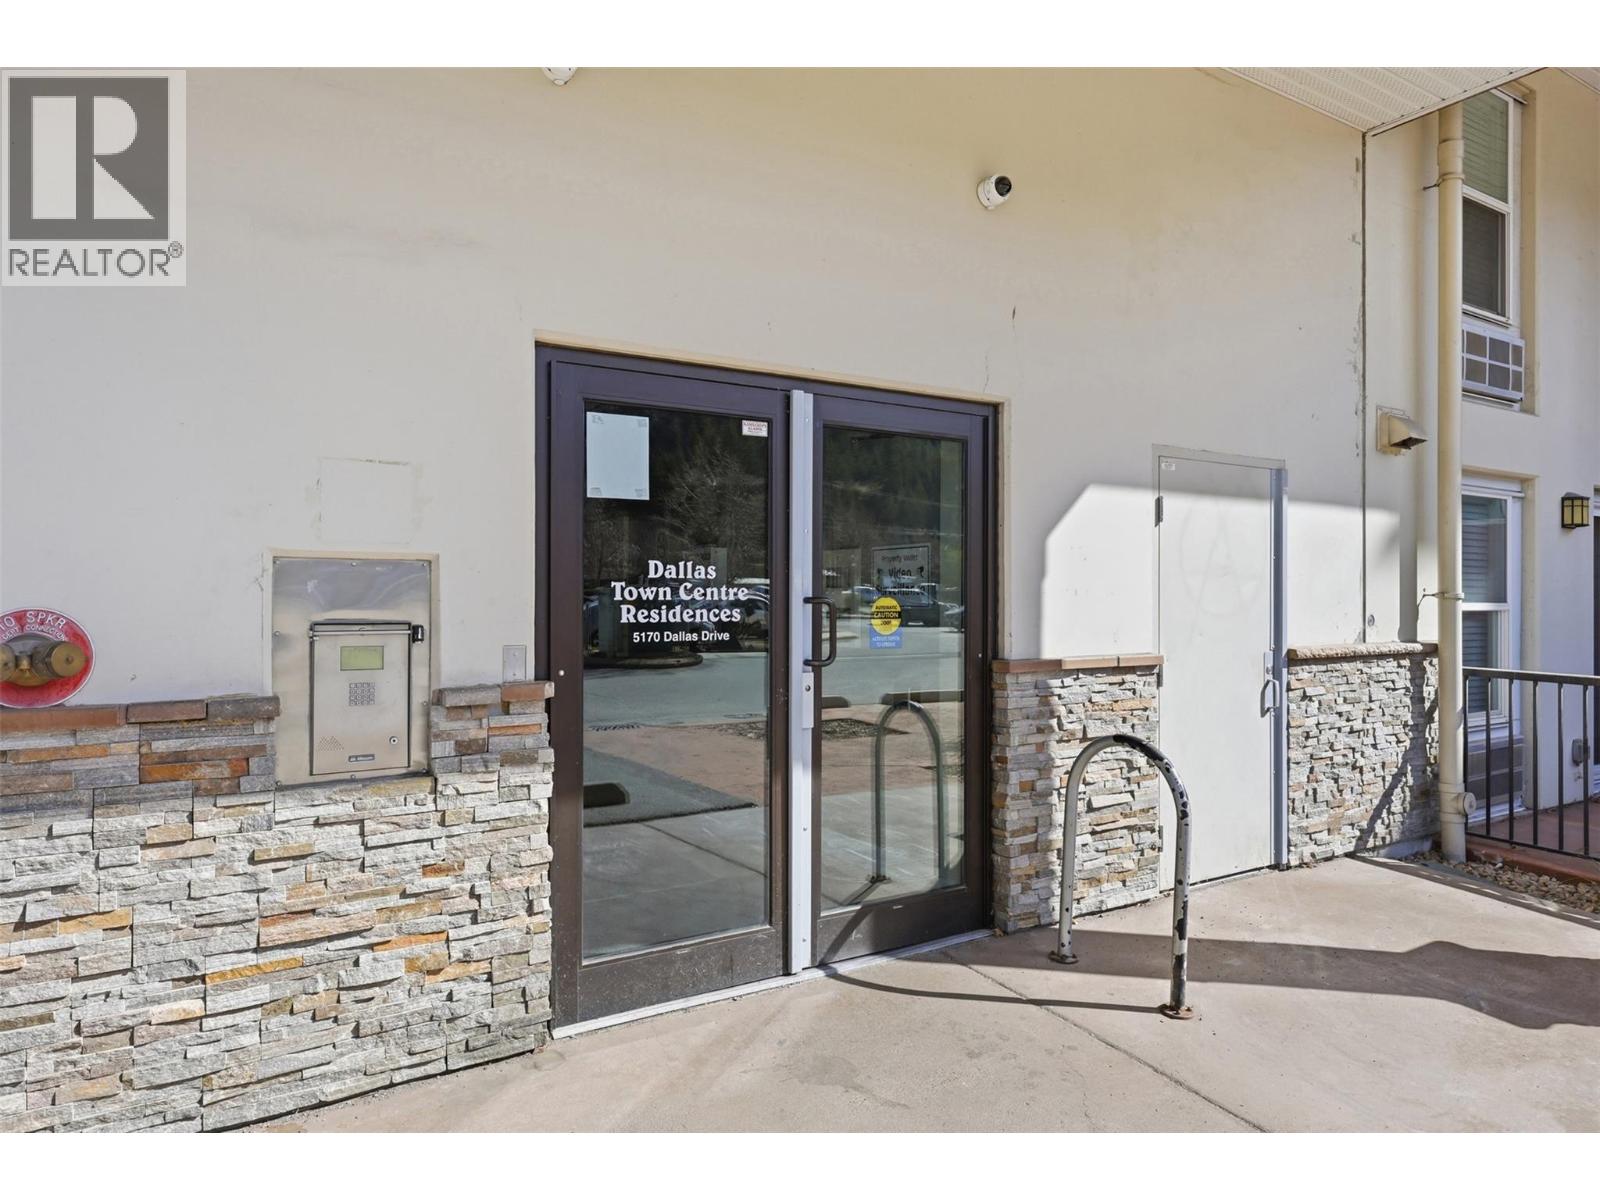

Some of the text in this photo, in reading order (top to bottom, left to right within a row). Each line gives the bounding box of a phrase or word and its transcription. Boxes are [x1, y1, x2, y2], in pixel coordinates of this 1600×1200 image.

[647, 559, 717, 579] Dallas
[610, 581, 750, 601] Town Centre
[26, 611, 66, 629] SPKR
[620, 604, 742, 623] Residences
[632, 630, 730, 643] 5170 Dallas Drive
